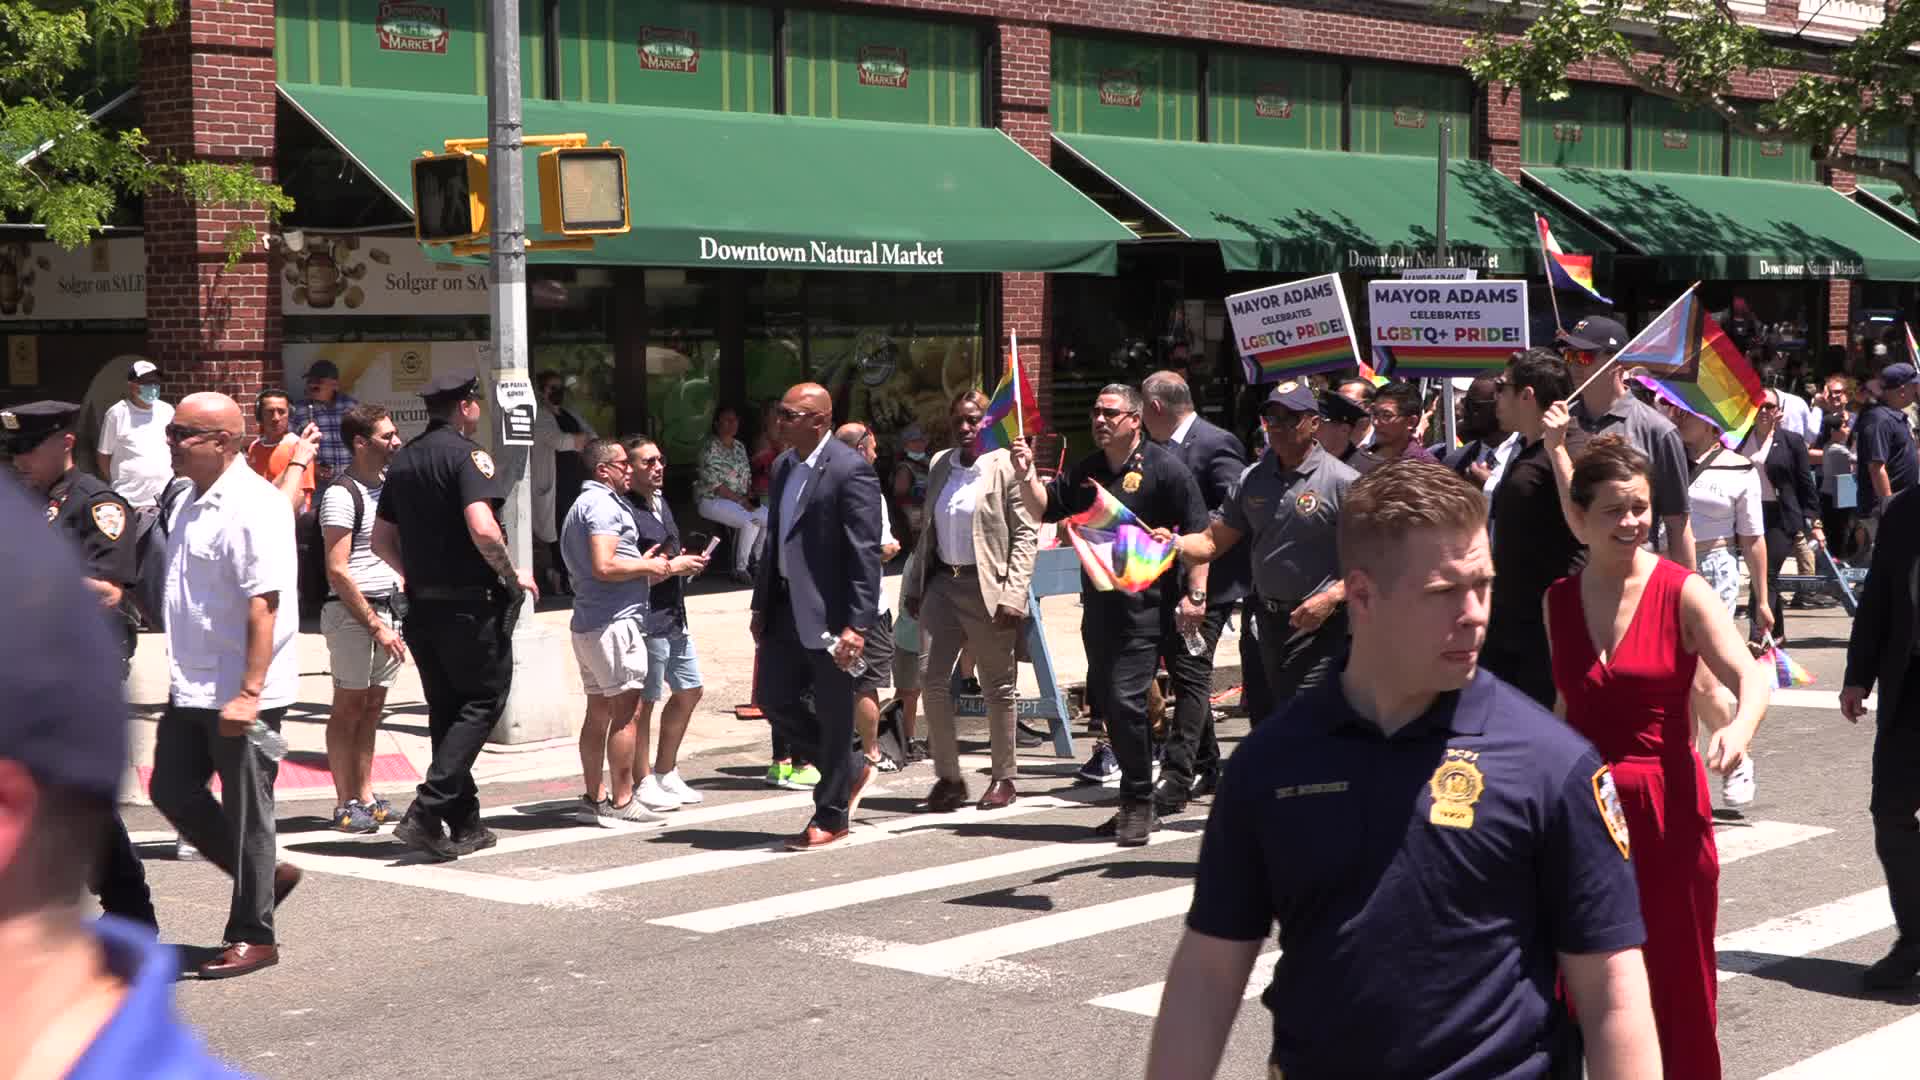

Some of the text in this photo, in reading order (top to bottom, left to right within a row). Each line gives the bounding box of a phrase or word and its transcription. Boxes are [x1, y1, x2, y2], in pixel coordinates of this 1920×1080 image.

[389, 33, 437, 52] MARKET
[648, 55, 691, 71] MARKET
[699, 237, 944, 265] Downtown Natural Market
[1348, 249, 1499, 269] Downtown Natral Market
[1760, 259, 1864, 275] Downtown Natural Market
[58, 272, 144, 297] Solgar on SALE
[385, 272, 488, 294] Solgar on SA
[1231, 283, 1333, 316] MAYOR ADAMS
[1375, 289, 1518, 304] MAYOR ADAMS
[1261, 308, 1312, 326] CELEBRATES
[1410, 310, 1481, 320] CELEBRATES
[1241, 318, 1344, 351] LGBTQ+ PRIDE!
[1377, 327, 1520, 344] LGBTQ+ PRIDE!
